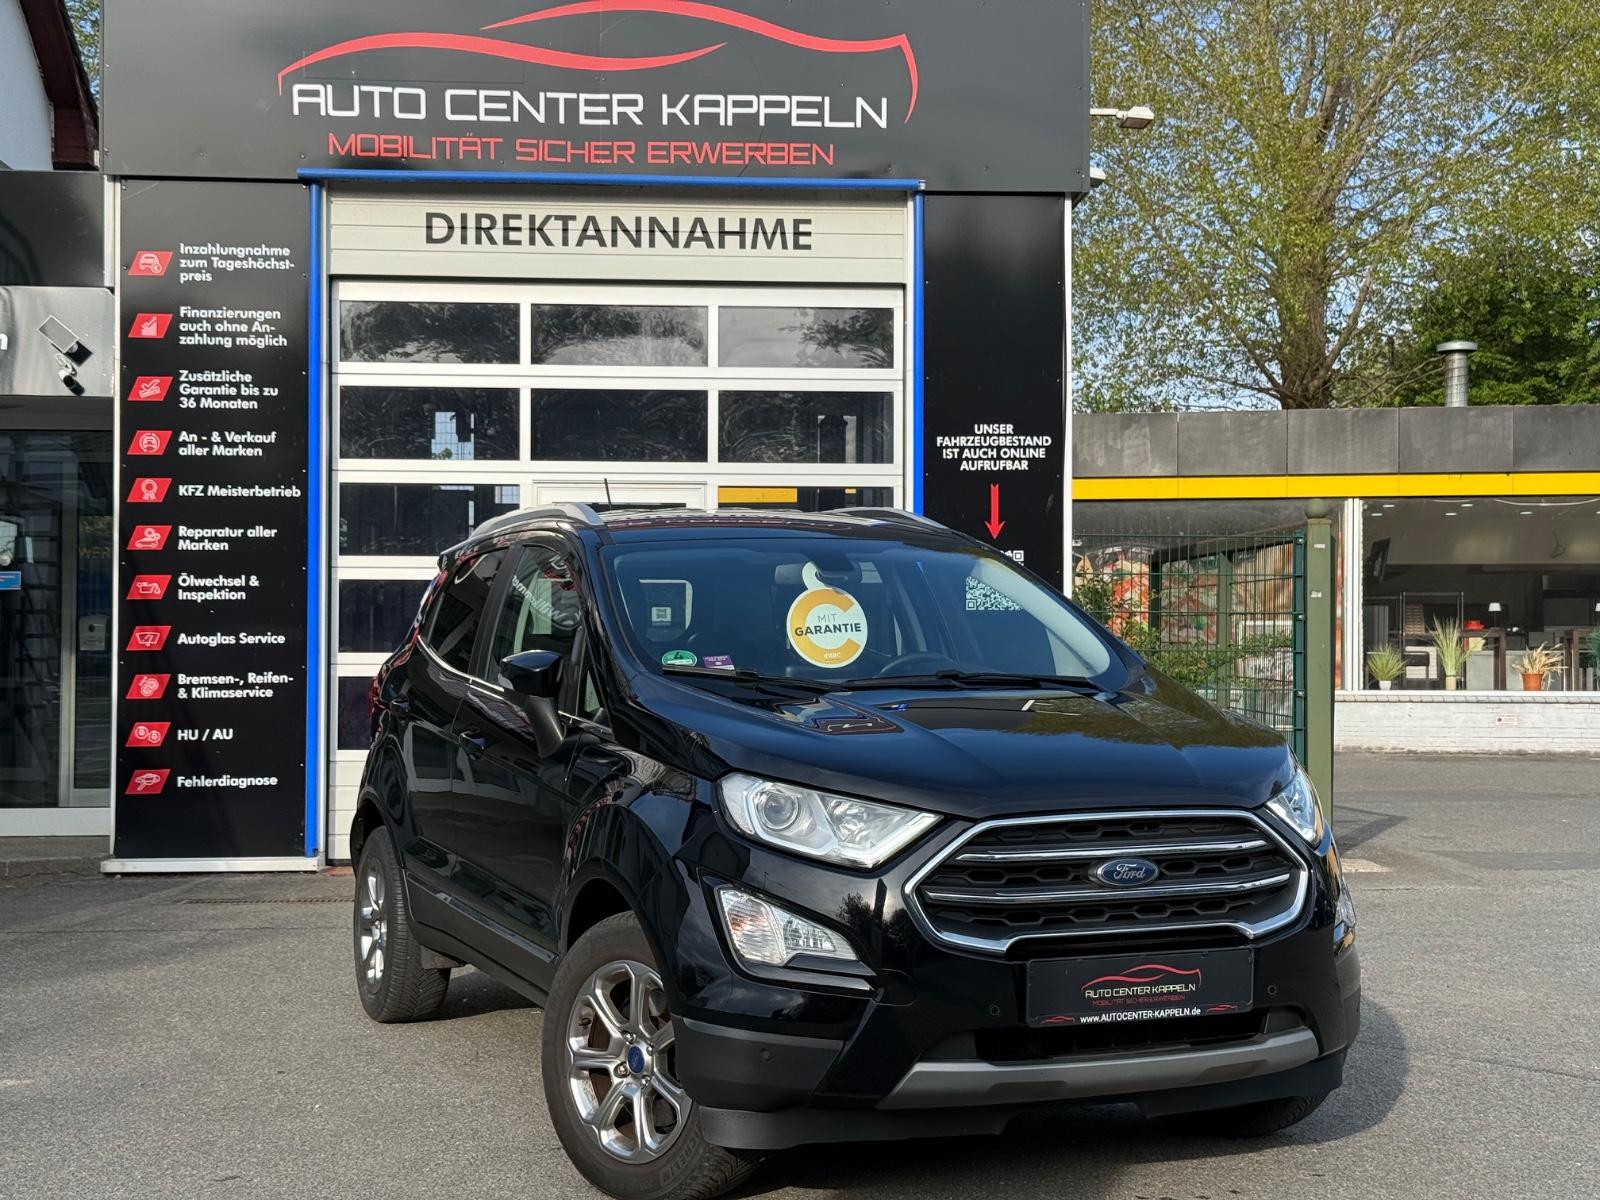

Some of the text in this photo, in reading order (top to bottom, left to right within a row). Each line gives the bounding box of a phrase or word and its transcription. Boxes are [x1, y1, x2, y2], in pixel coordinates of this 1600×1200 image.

[292, 83, 888, 130] AUTO CENTER KAPPELN
[328, 132, 834, 165] MOBILITÄT SICHER ERWERBEN
[425, 212, 813, 251] DIREKTANNAHME
[180, 243, 290, 257] Inzahlungnahme
[180, 257, 295, 270] zum Tageshöchst-
[180, 271, 212, 283] preis
[180, 307, 281, 320] Finanzierungen
[180, 321, 275, 333] auch ohne An-
[179, 334, 287, 348] zahlung möglich
[179, 370, 252, 382] Zusätzliche
[179, 385, 278, 396] Garantie bis zu
[179, 398, 257, 409] 36 Monaten
[974, 424, 1013, 434] UNSER
[179, 432, 197, 442] An
[211, 432, 221, 442] &
[225, 431, 276, 443] Verkauf
[937, 436, 1051, 446] FAHRZEUGBESTAND
[179, 445, 262, 456] aller Marken
[943, 448, 1045, 459] IST AUCH ONLINE
[960, 460, 1028, 471] AUFRUFBAR
[179, 485, 301, 497] KFZ Meisterbetrieb
[178, 526, 277, 539] Reparatur aller
[178, 540, 228, 551] Marken
[178, 573, 259, 587] Ölwechsel &
[178, 589, 246, 602] Inspektion
[818, 614, 838, 622] MIT
[794, 622, 862, 636] GARANTIE
[177, 633, 285, 647] Autoglas Service
[674, 652, 682, 660] 4
[178, 672, 293, 686] Bremsen-, Reifen-
[178, 687, 273, 699] & Klimaservice
[177, 728, 233, 741] HU / AU
[177, 775, 277, 789] Fehlerdiagnose
[1114, 863, 1145, 880] Ford
[1085, 984, 1195, 998] AUTO CENTER KAPPELN
[1080, 1008, 1201, 1024] www.AUTOCENTER-KAPPELN.de
